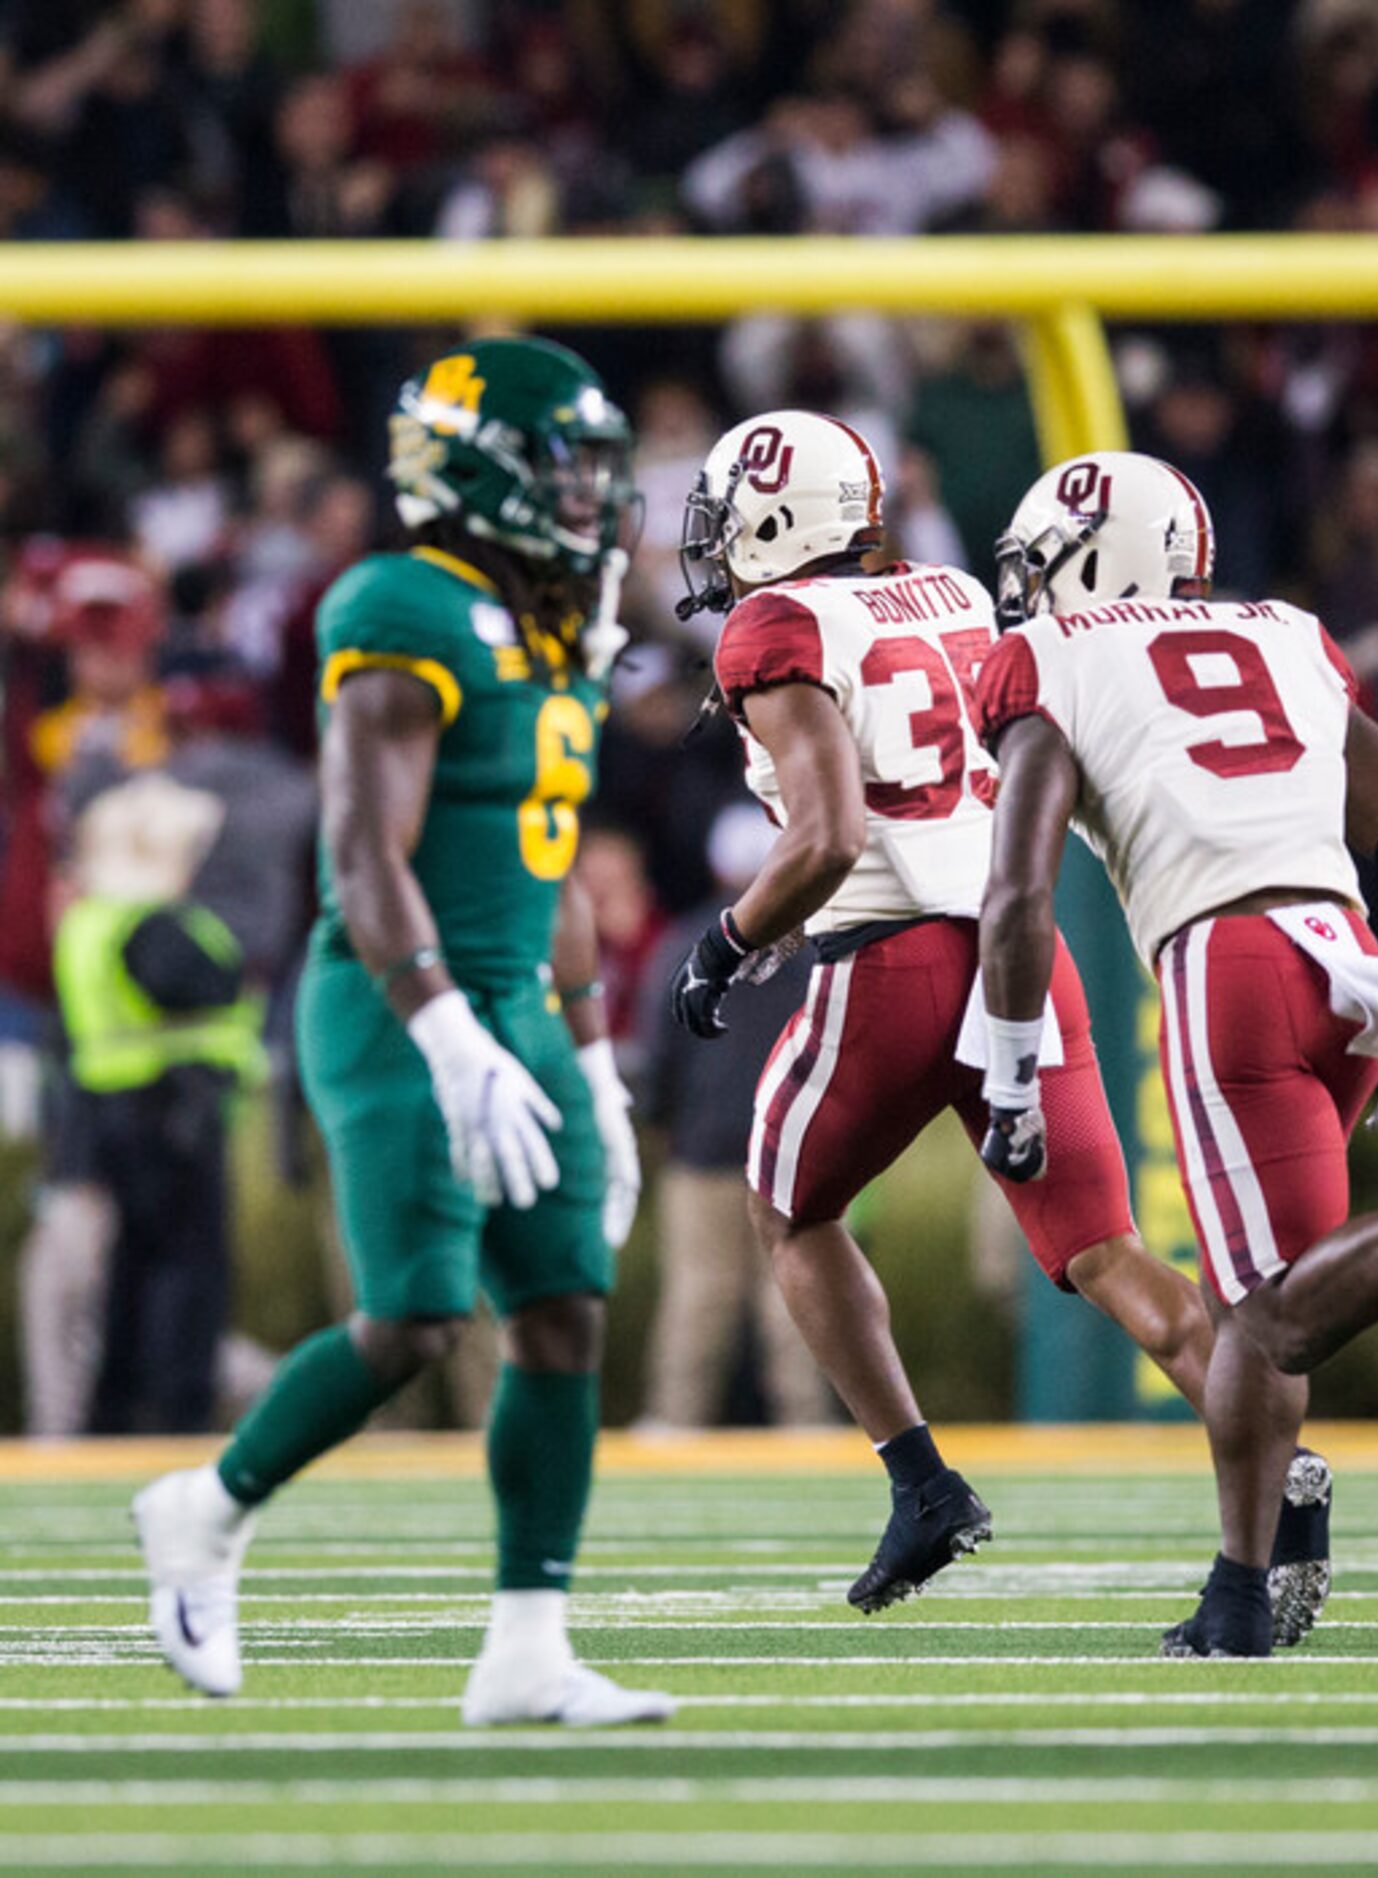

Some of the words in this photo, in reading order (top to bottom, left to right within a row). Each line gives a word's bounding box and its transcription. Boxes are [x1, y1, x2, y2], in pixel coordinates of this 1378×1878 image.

[740, 426, 794, 494] OU
[1057, 462, 1111, 524] OU
[853, 574, 972, 624] BONITTO
[1146, 630, 1306, 779] 9
[518, 695, 593, 880] 6
